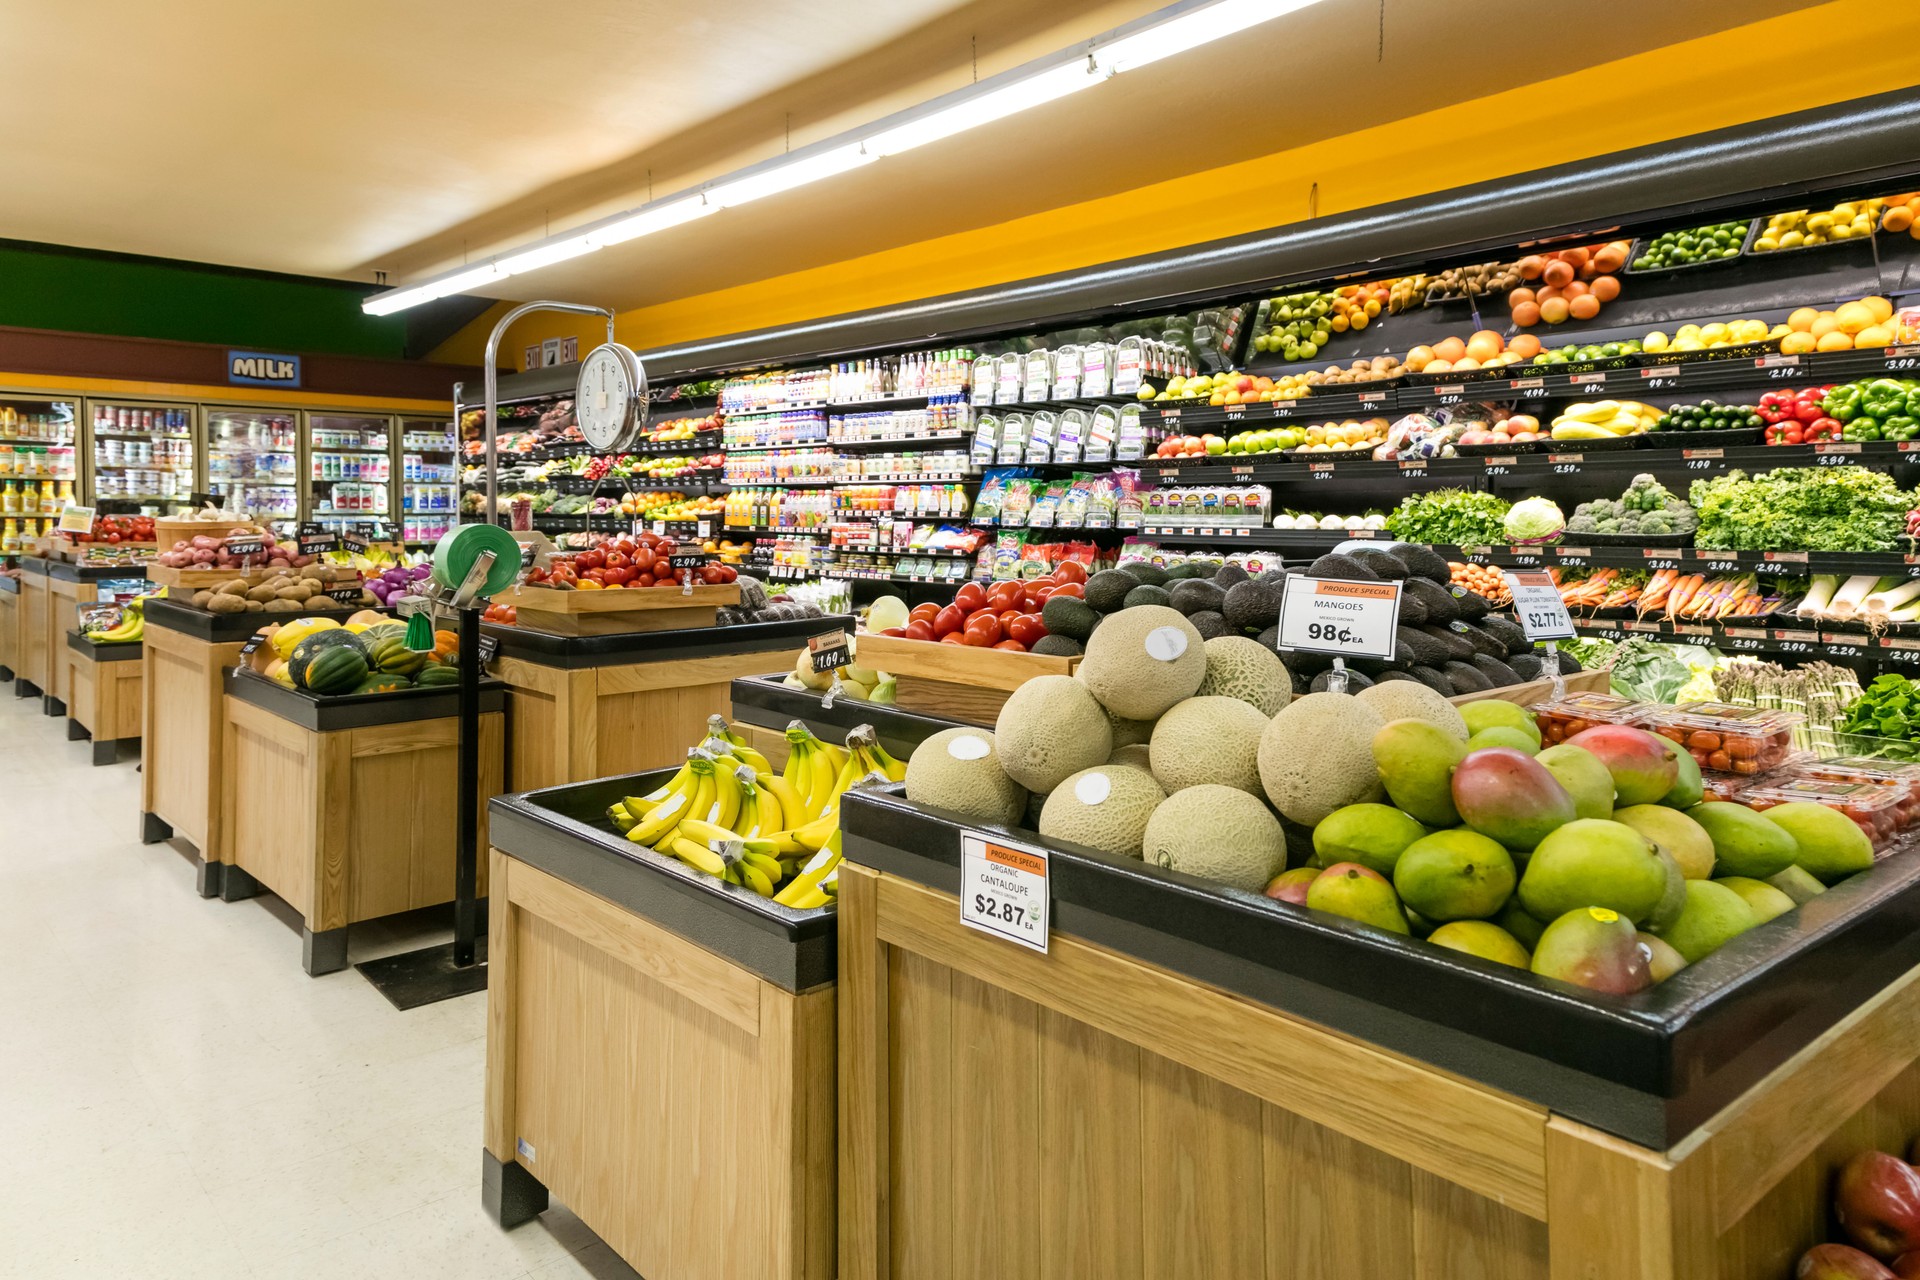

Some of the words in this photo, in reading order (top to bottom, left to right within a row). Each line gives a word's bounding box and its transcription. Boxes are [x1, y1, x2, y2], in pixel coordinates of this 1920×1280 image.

[232, 357, 295, 380] MILK
[1323, 585, 1359, 593] PRODUCE
[1314, 600, 1364, 611] MANGOES
[1528, 612, 1557, 629] $2.77
[822, 639, 841, 648] BANANAS
[990, 849, 1018, 864] PRODUCE
[1019, 858, 1041, 870] SPECIAL
[990, 863, 1019, 878] ORGANIC
[980, 874, 1029, 896] CANTALOUPE
[975, 893, 1025, 926] $2.87
[1024, 921, 1034, 931] EA
